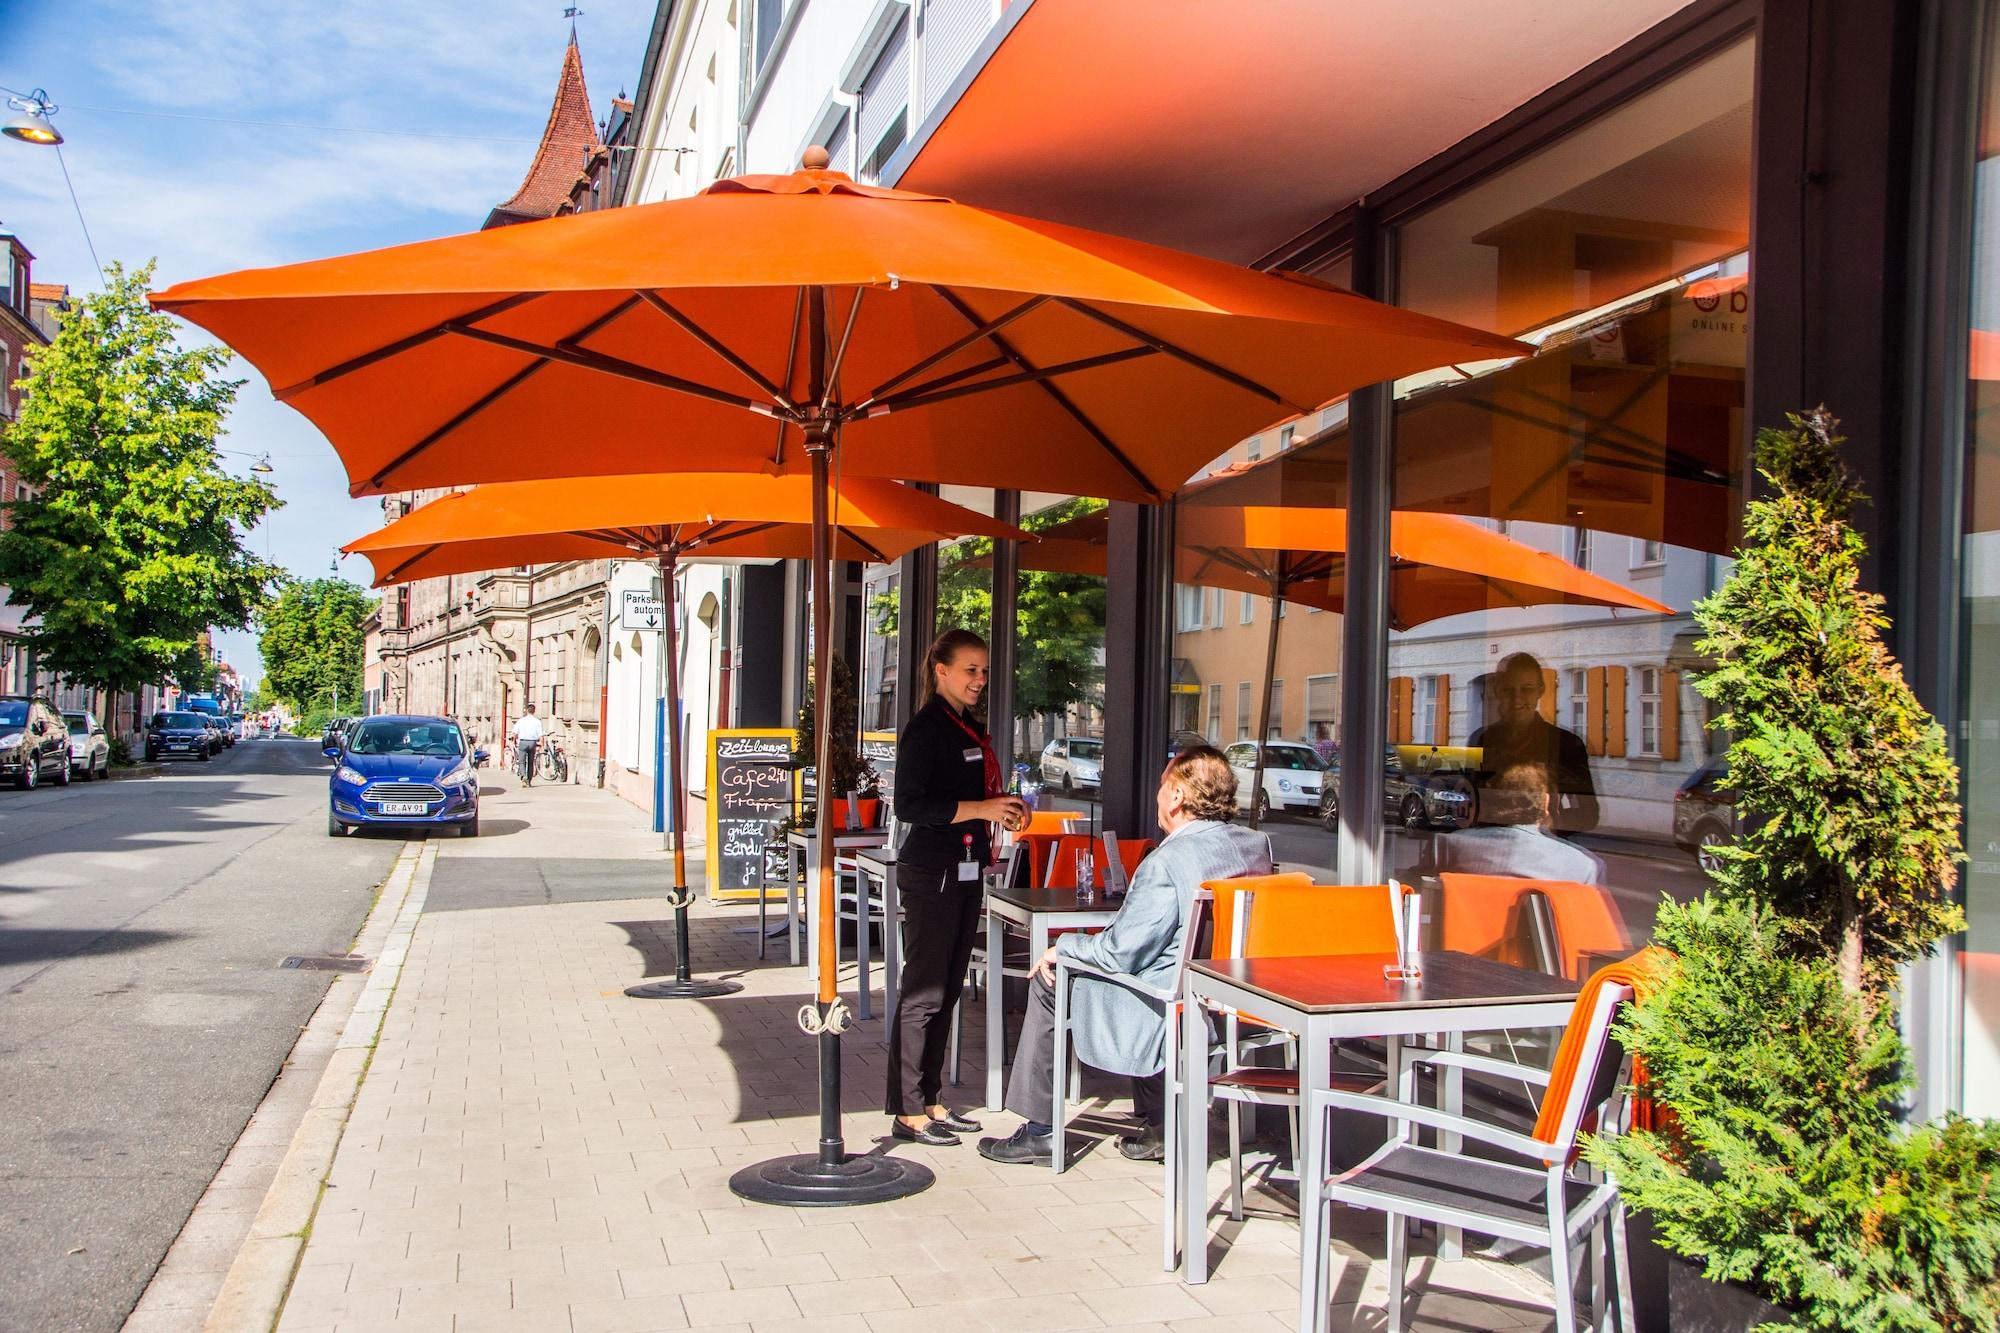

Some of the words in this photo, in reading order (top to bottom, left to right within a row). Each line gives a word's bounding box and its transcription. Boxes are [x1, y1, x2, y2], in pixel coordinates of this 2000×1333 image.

[1692, 319, 1735, 333] ONLINE
[386, 804, 397, 812] ER
[727, 822, 764, 842] grilled
[742, 861, 757, 886] je
